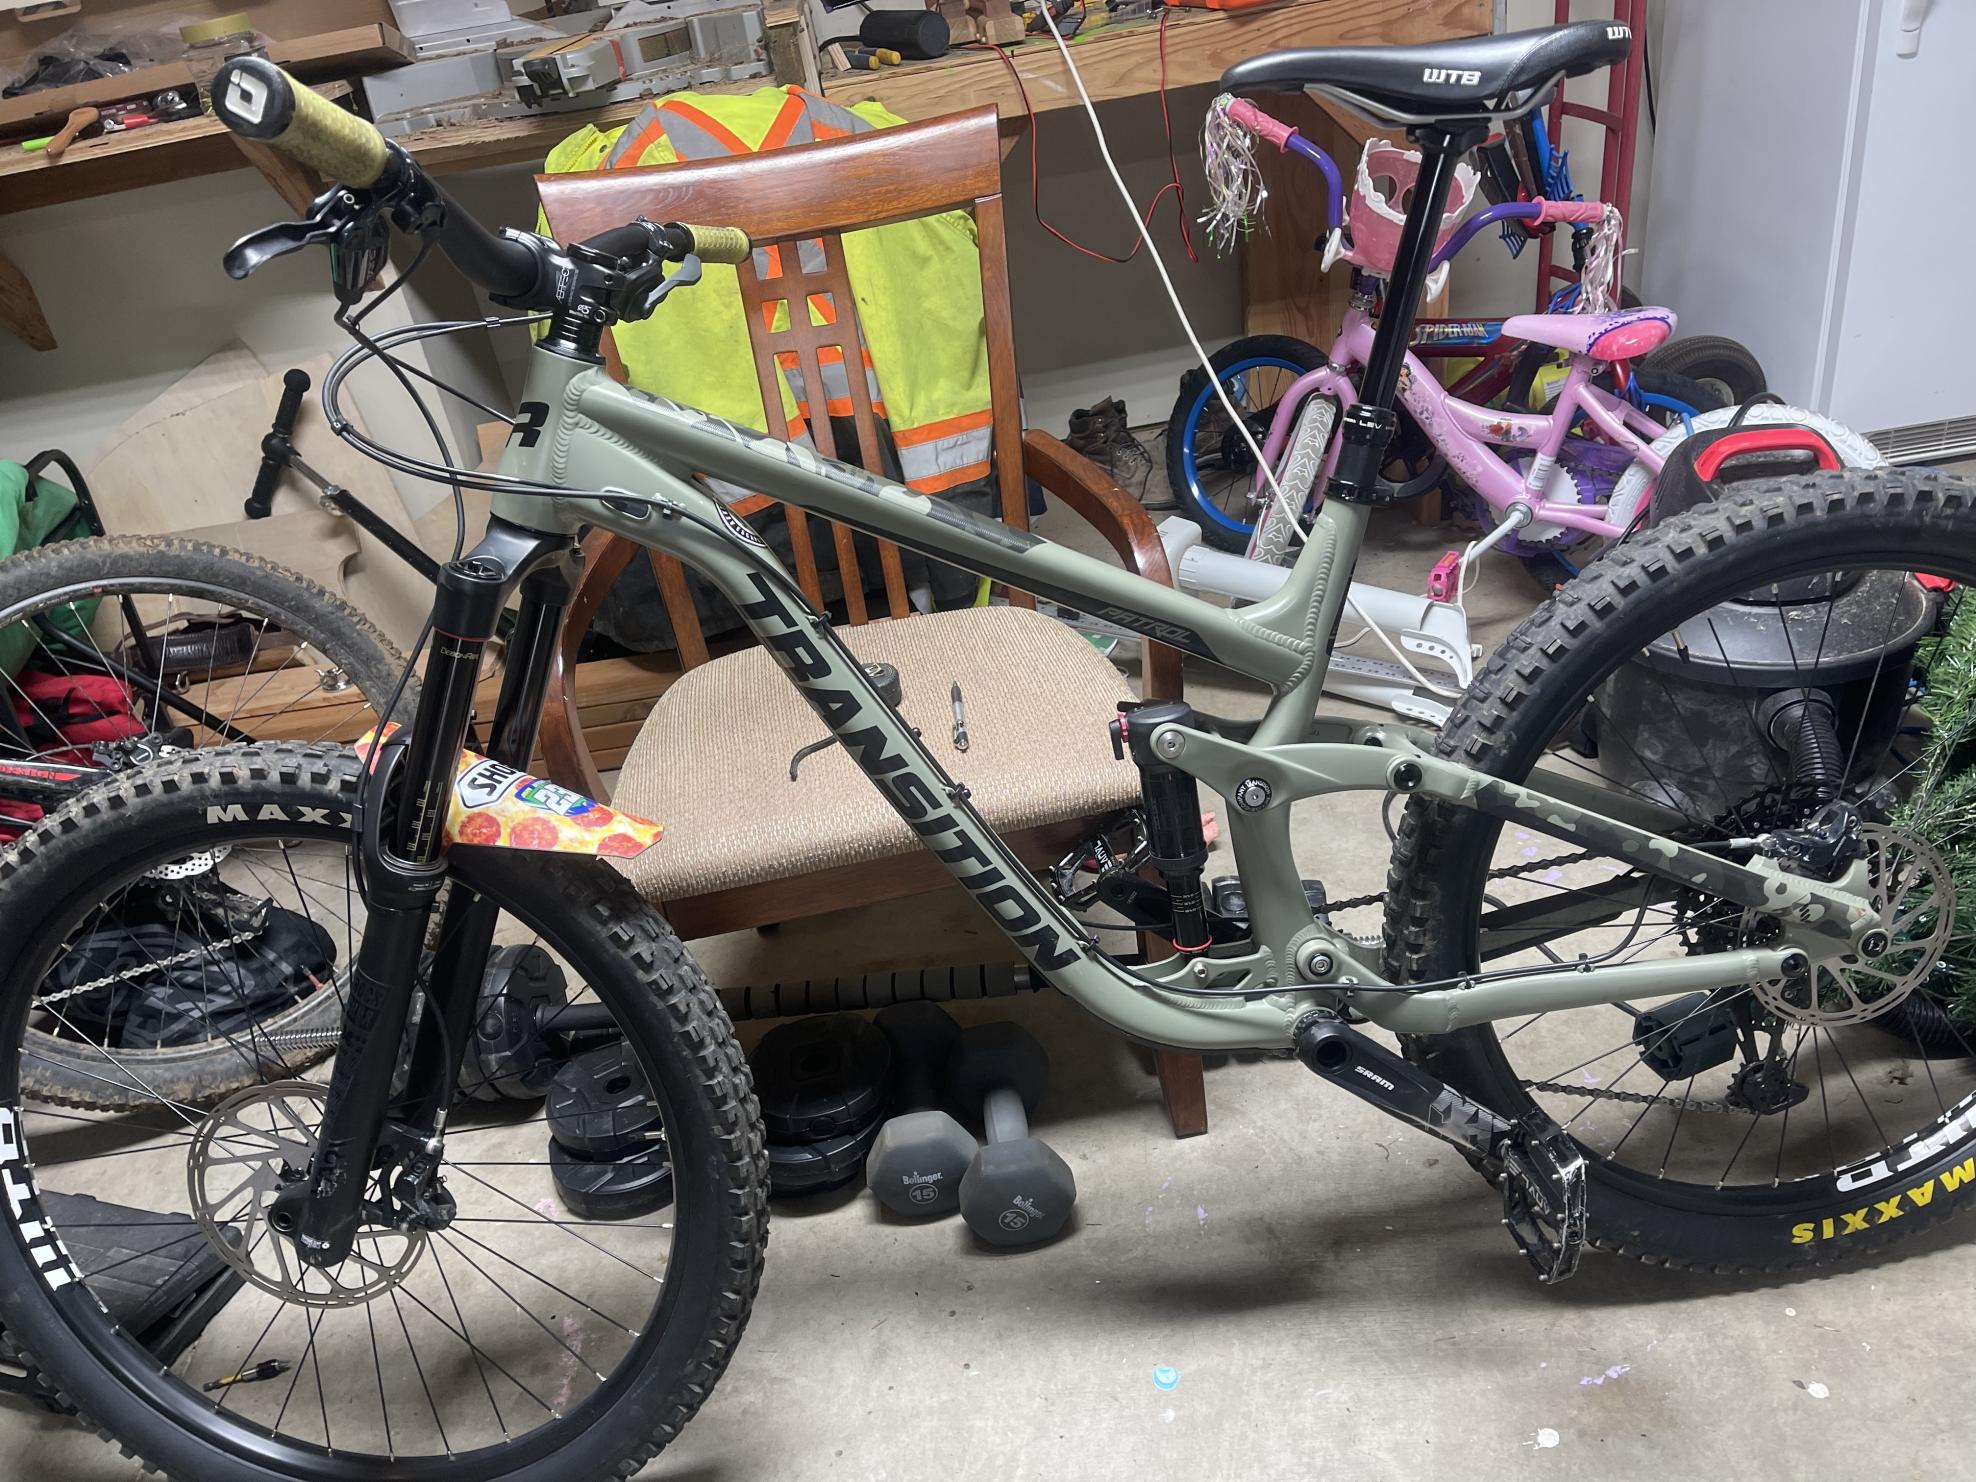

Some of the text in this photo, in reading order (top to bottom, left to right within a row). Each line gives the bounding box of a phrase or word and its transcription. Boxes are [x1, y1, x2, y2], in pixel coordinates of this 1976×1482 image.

[1423, 68, 1481, 86] WTB
[1097, 606, 1191, 643] PATROL
[746, 572, 1082, 972] TRANSITION
[1354, 1065, 1395, 1091] SRAM
[911, 1188, 935, 1201] 15
[1791, 1157, 1976, 1244] MAXXIS
[1005, 1212, 1026, 1228] 15
